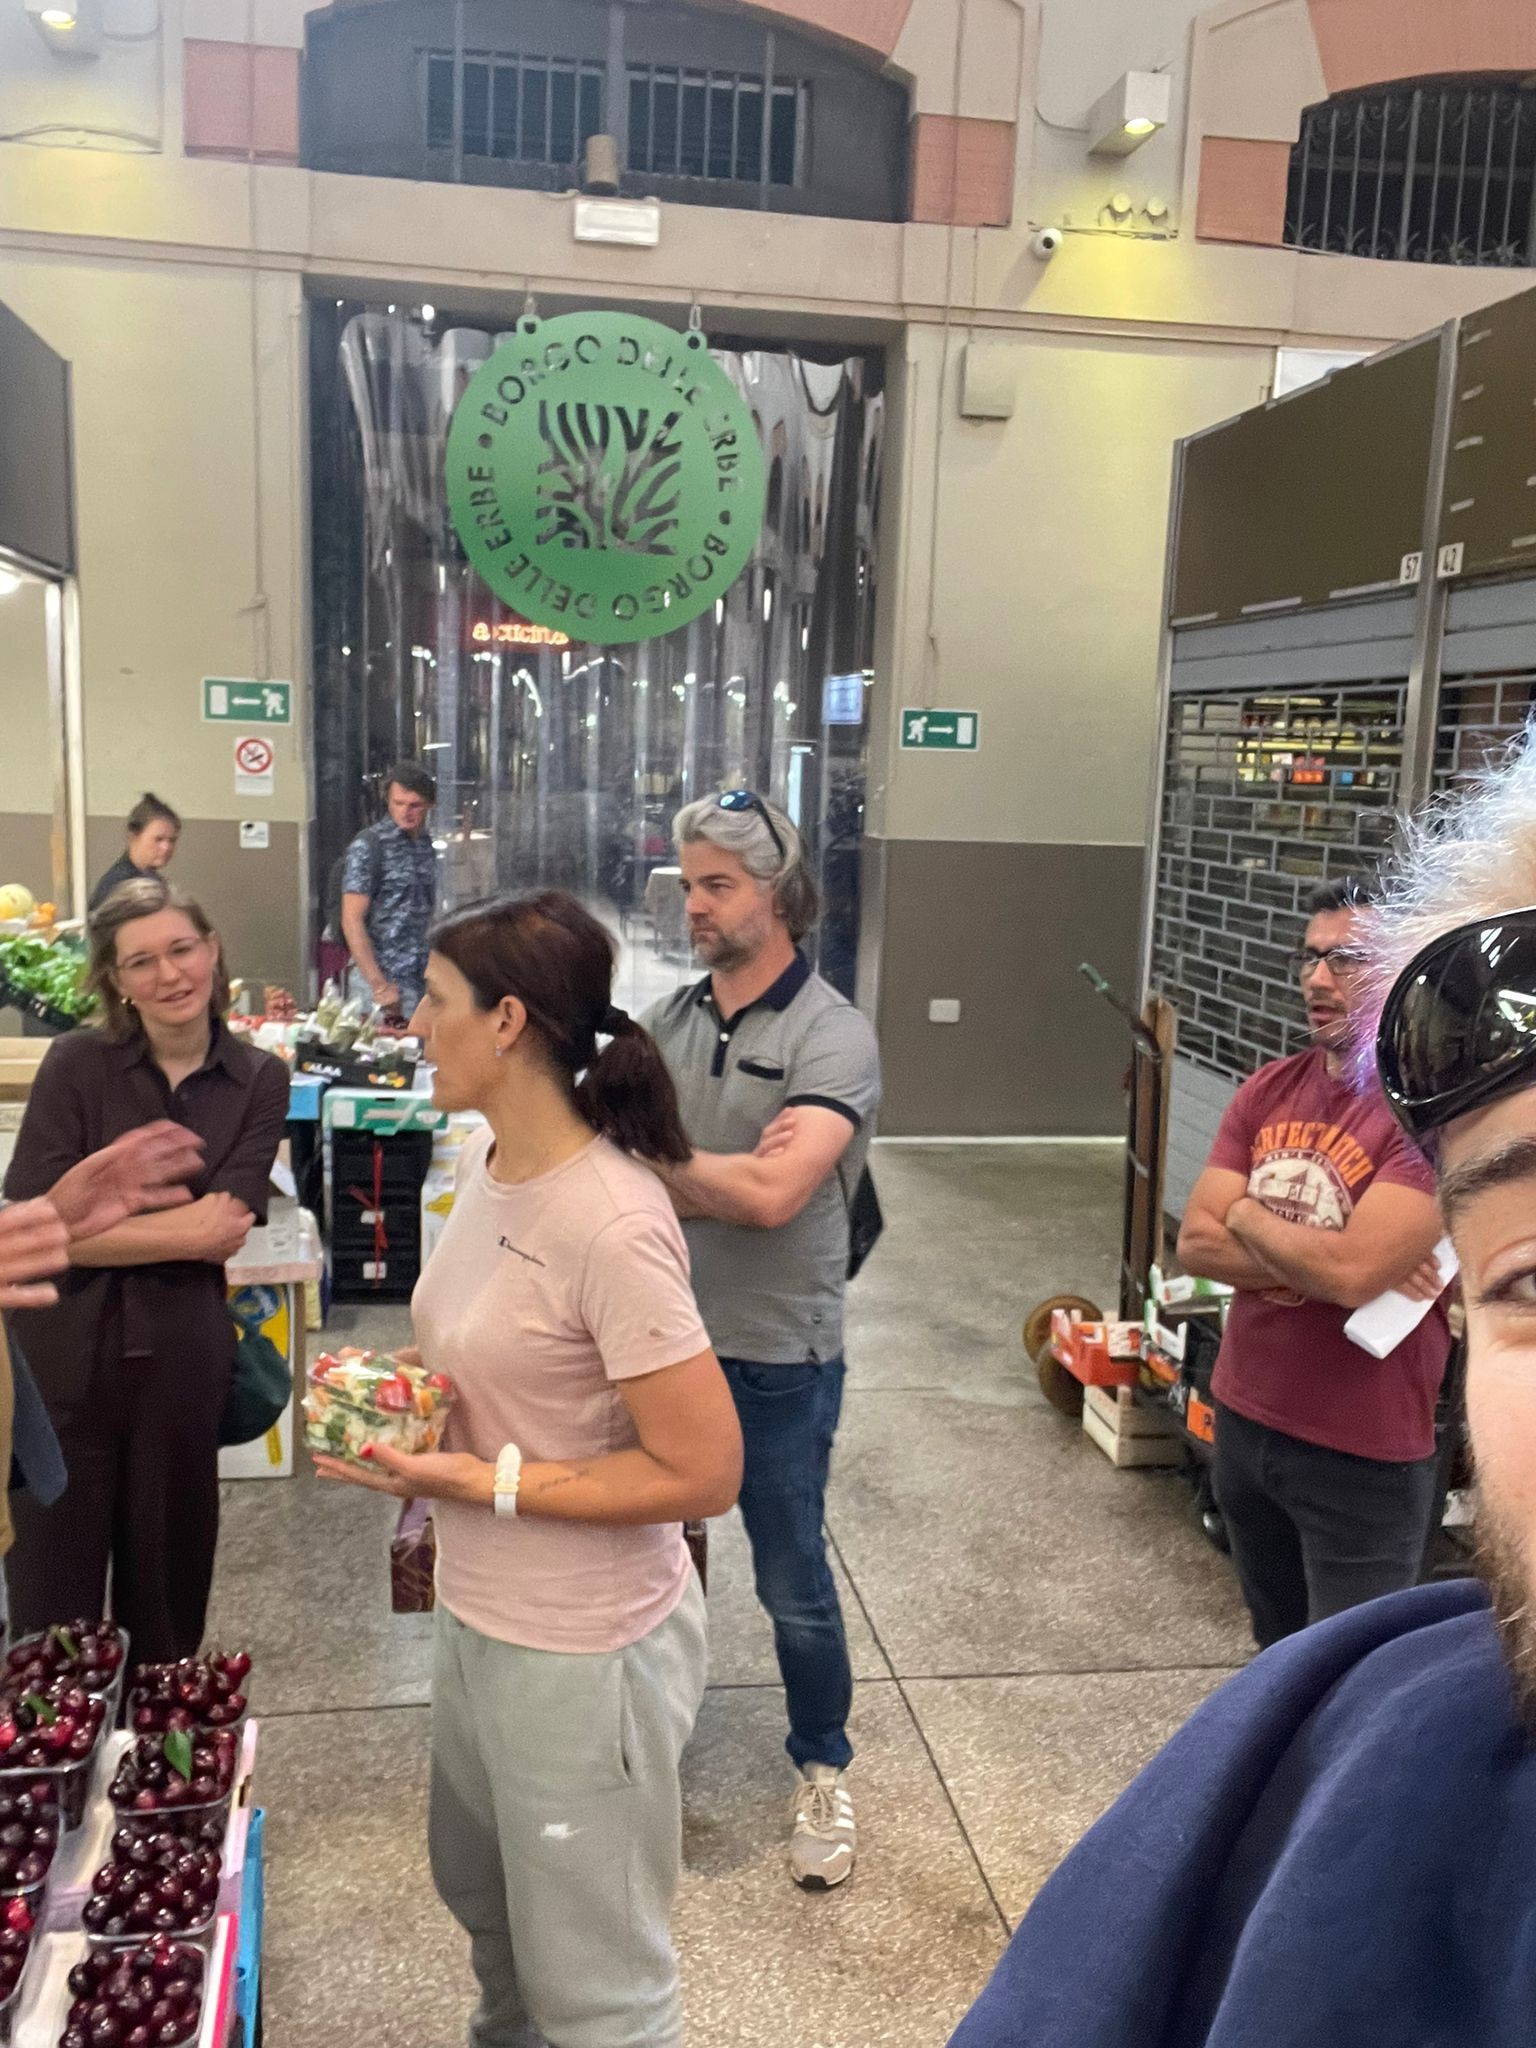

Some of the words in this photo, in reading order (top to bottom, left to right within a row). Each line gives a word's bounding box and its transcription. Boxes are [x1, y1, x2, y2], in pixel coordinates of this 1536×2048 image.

[480, 334, 601, 427] BORGO
[467, 466, 513, 551] ERBE
[504, 553, 597, 620] DELLE
[611, 533, 729, 622] BORGO
[1405, 556, 1419, 580] 57
